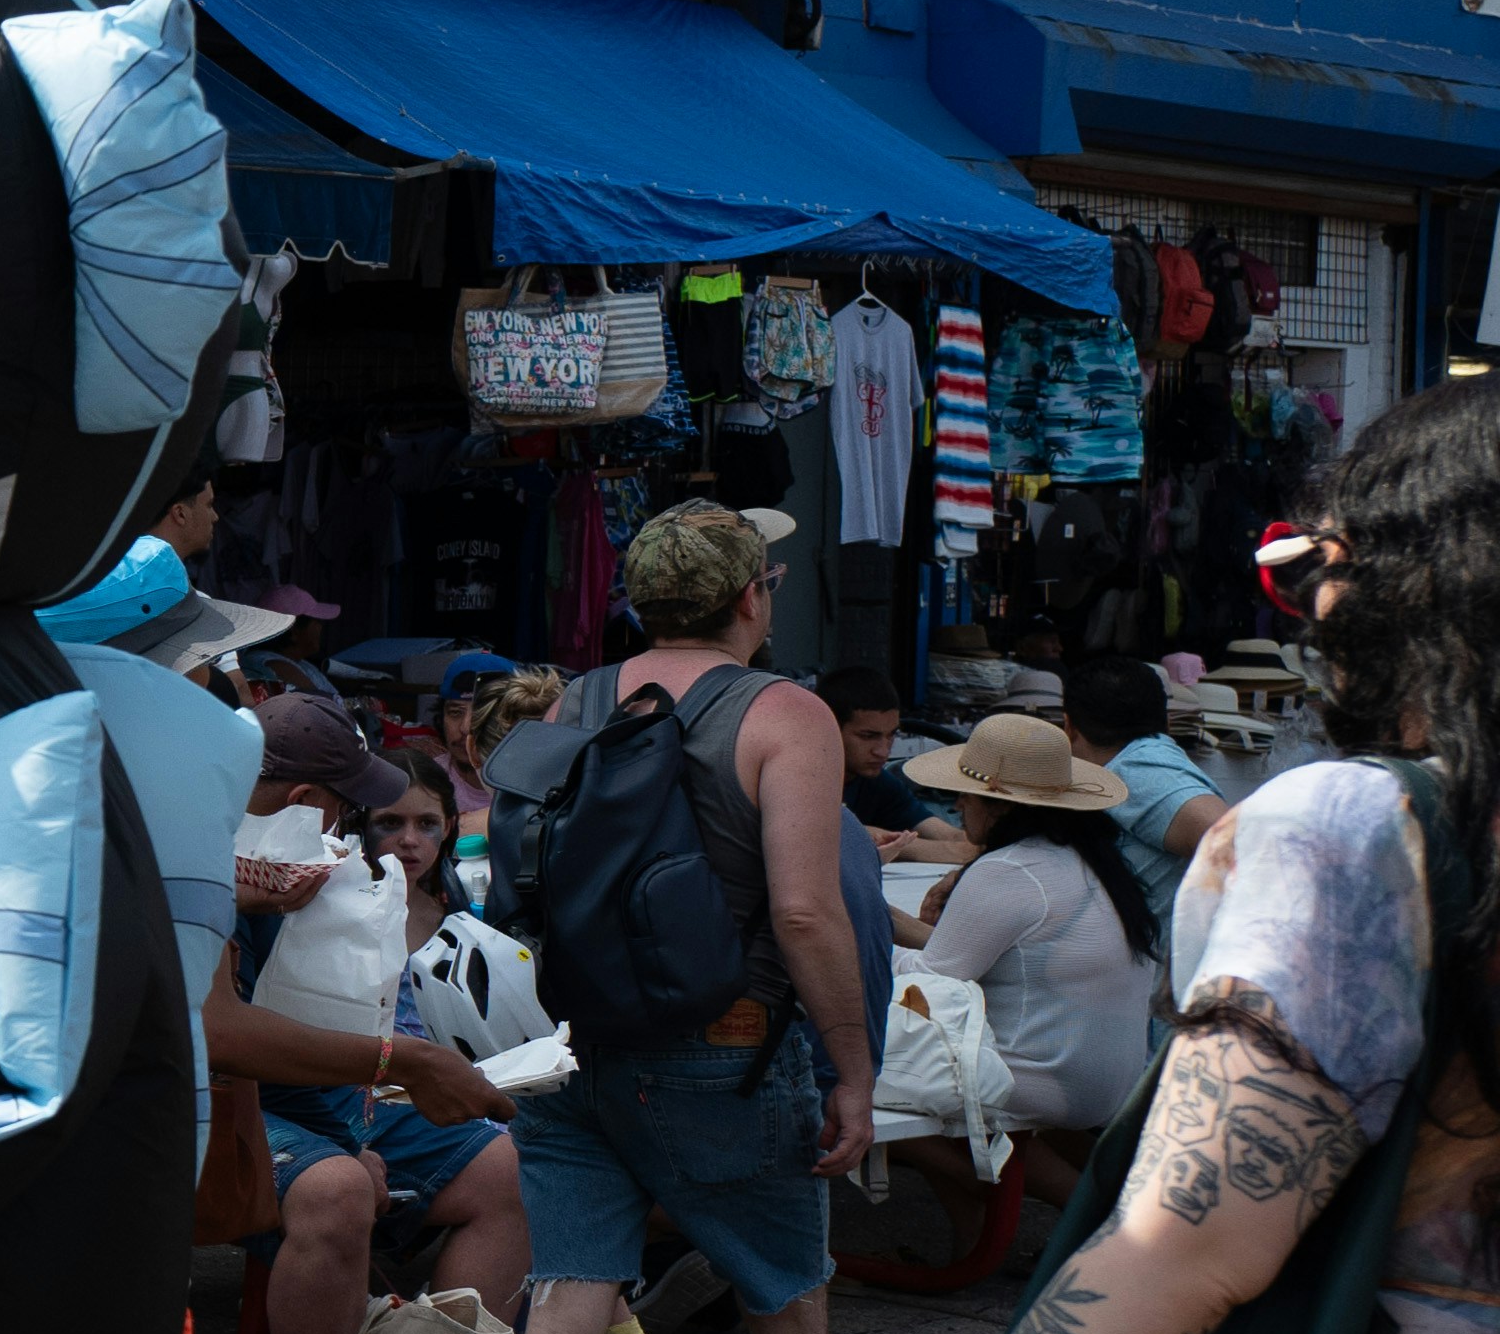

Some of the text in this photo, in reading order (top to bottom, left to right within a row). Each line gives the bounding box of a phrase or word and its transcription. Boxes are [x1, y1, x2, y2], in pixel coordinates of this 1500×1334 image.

[492, 310, 576, 336] YORK NEW
[469, 357, 532, 385] NEW
